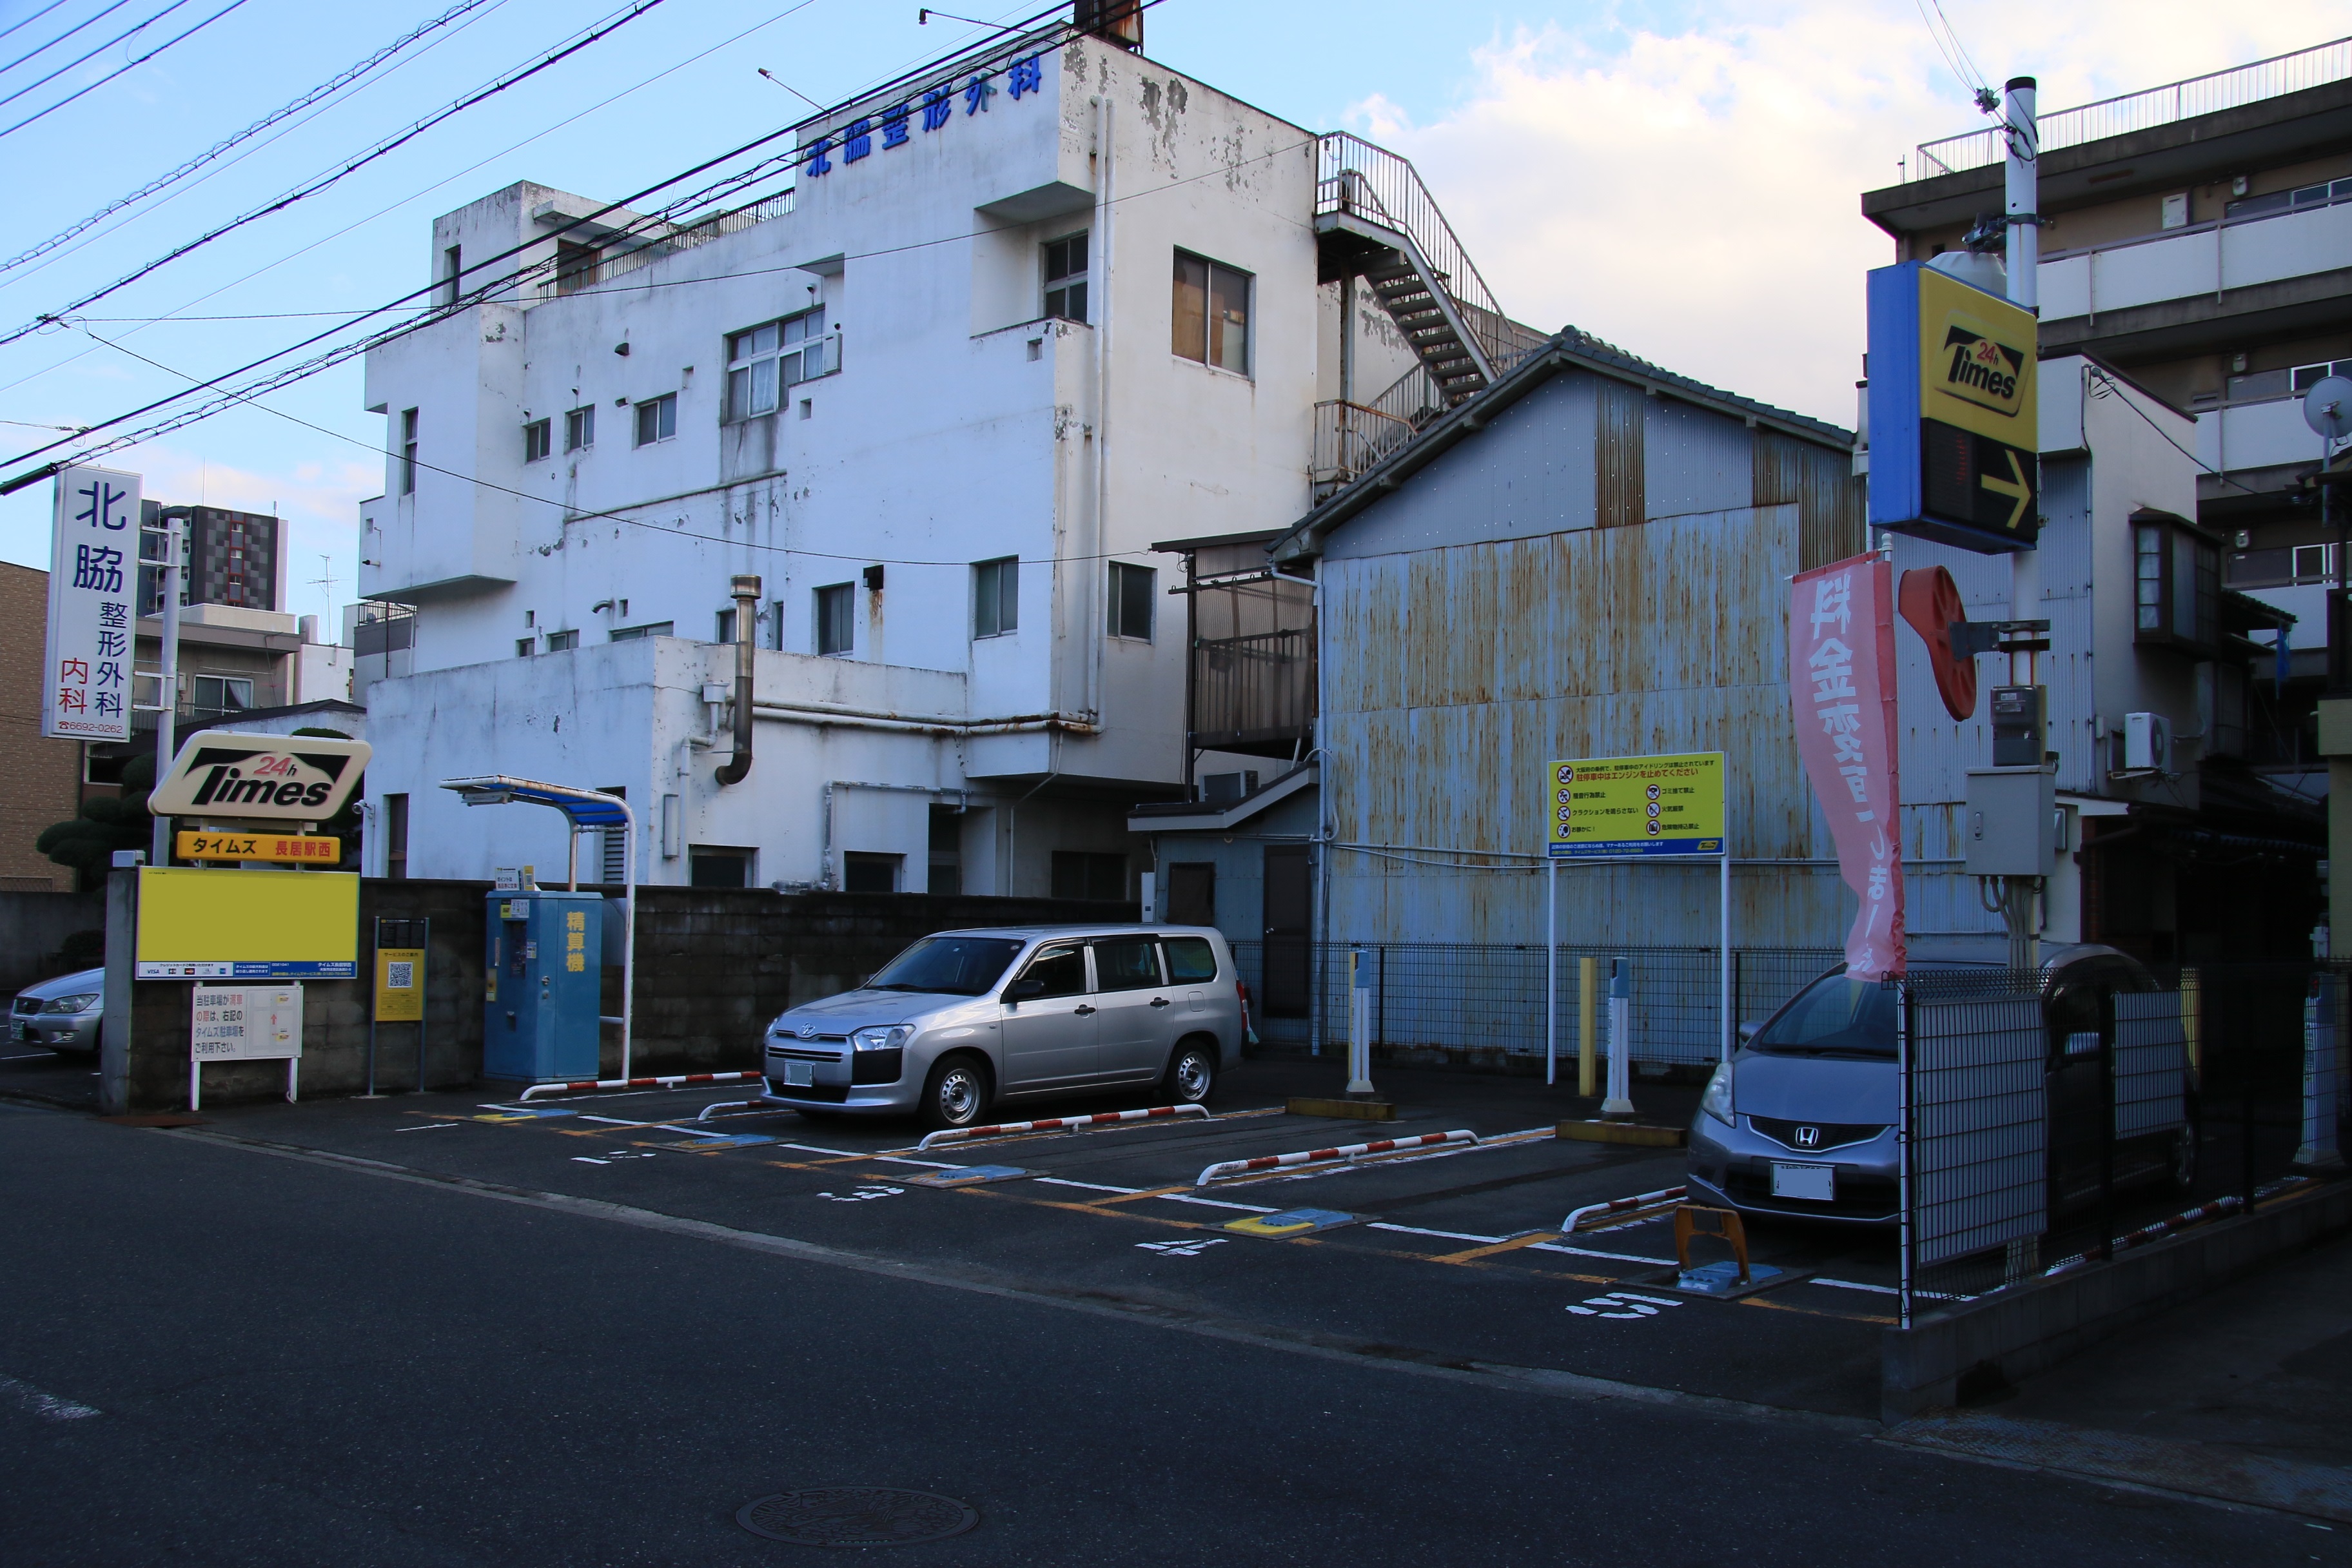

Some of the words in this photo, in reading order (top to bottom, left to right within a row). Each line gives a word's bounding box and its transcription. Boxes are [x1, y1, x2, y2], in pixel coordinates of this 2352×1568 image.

[1976, 342, 1999, 366] 24h
[1946, 337, 2017, 400] Times
[73, 481, 127, 594] 北脇
[94, 601, 128, 718] 整形外科
[59, 657, 89, 715] 内科
[70, 721, 123, 734] 6692-0262
[253, 756, 297, 777] 24h
[1576, 769, 1699, 781] 駐停車中はエンジンを止めてください
[186, 758, 333, 807] Times
[1572, 807, 1639, 816] クラクションを鳴らさない
[193, 838, 257, 854] タイムズ
[275, 840, 331, 858] 長居駅西
[566, 911, 585, 972] 精算機
[197, 994, 243, 1006] 当駐車場が満車
[196, 1010, 243, 1021] の際は、右記の
[195, 1042, 237, 1054] ご利用下さい。
